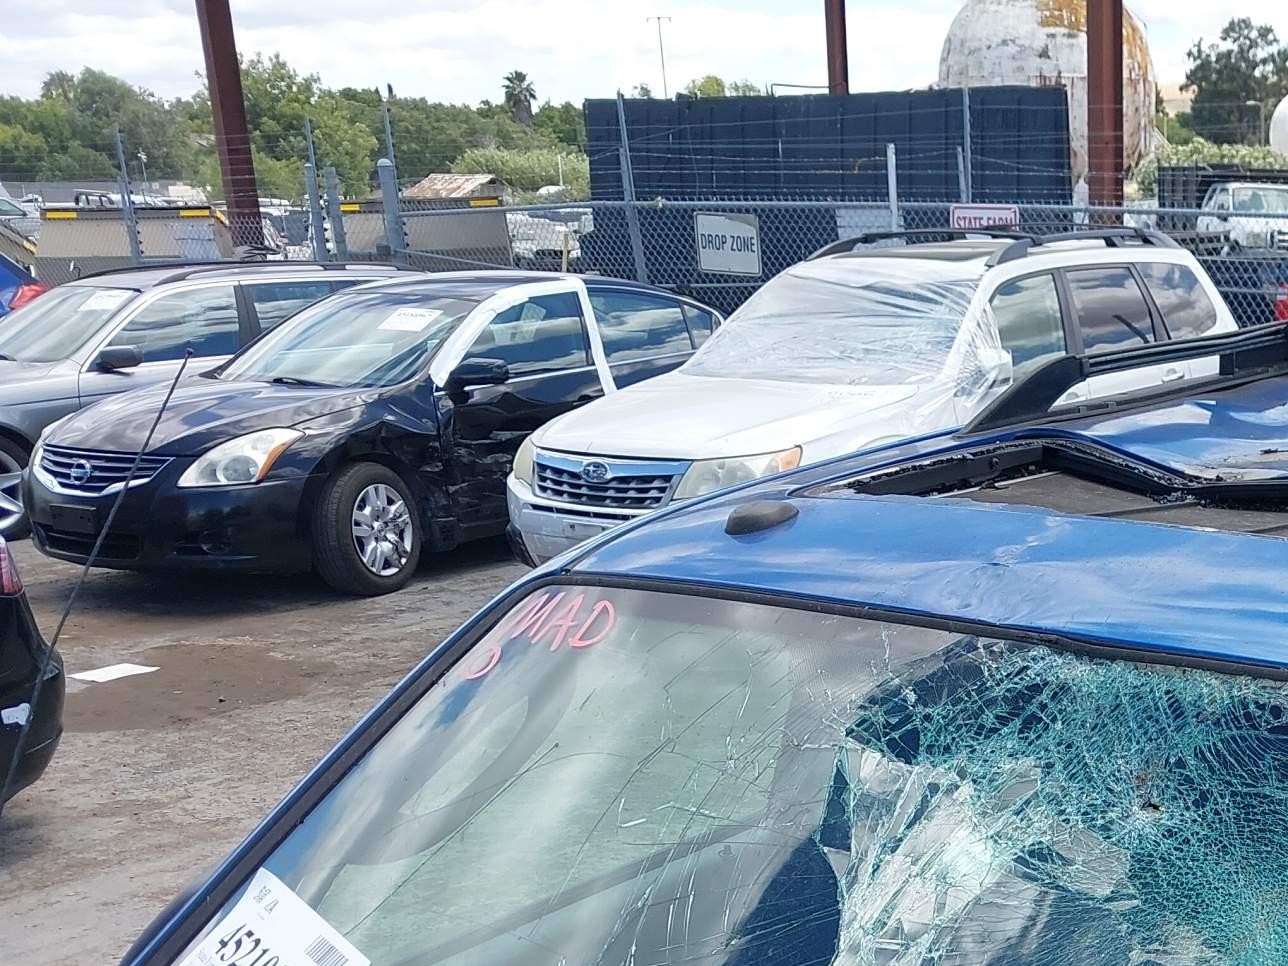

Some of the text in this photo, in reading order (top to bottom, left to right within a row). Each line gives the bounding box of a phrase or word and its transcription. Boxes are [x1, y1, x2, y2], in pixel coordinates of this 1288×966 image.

[699, 233, 756, 253] DROP ZONE
[508, 591, 617, 652] MAD
